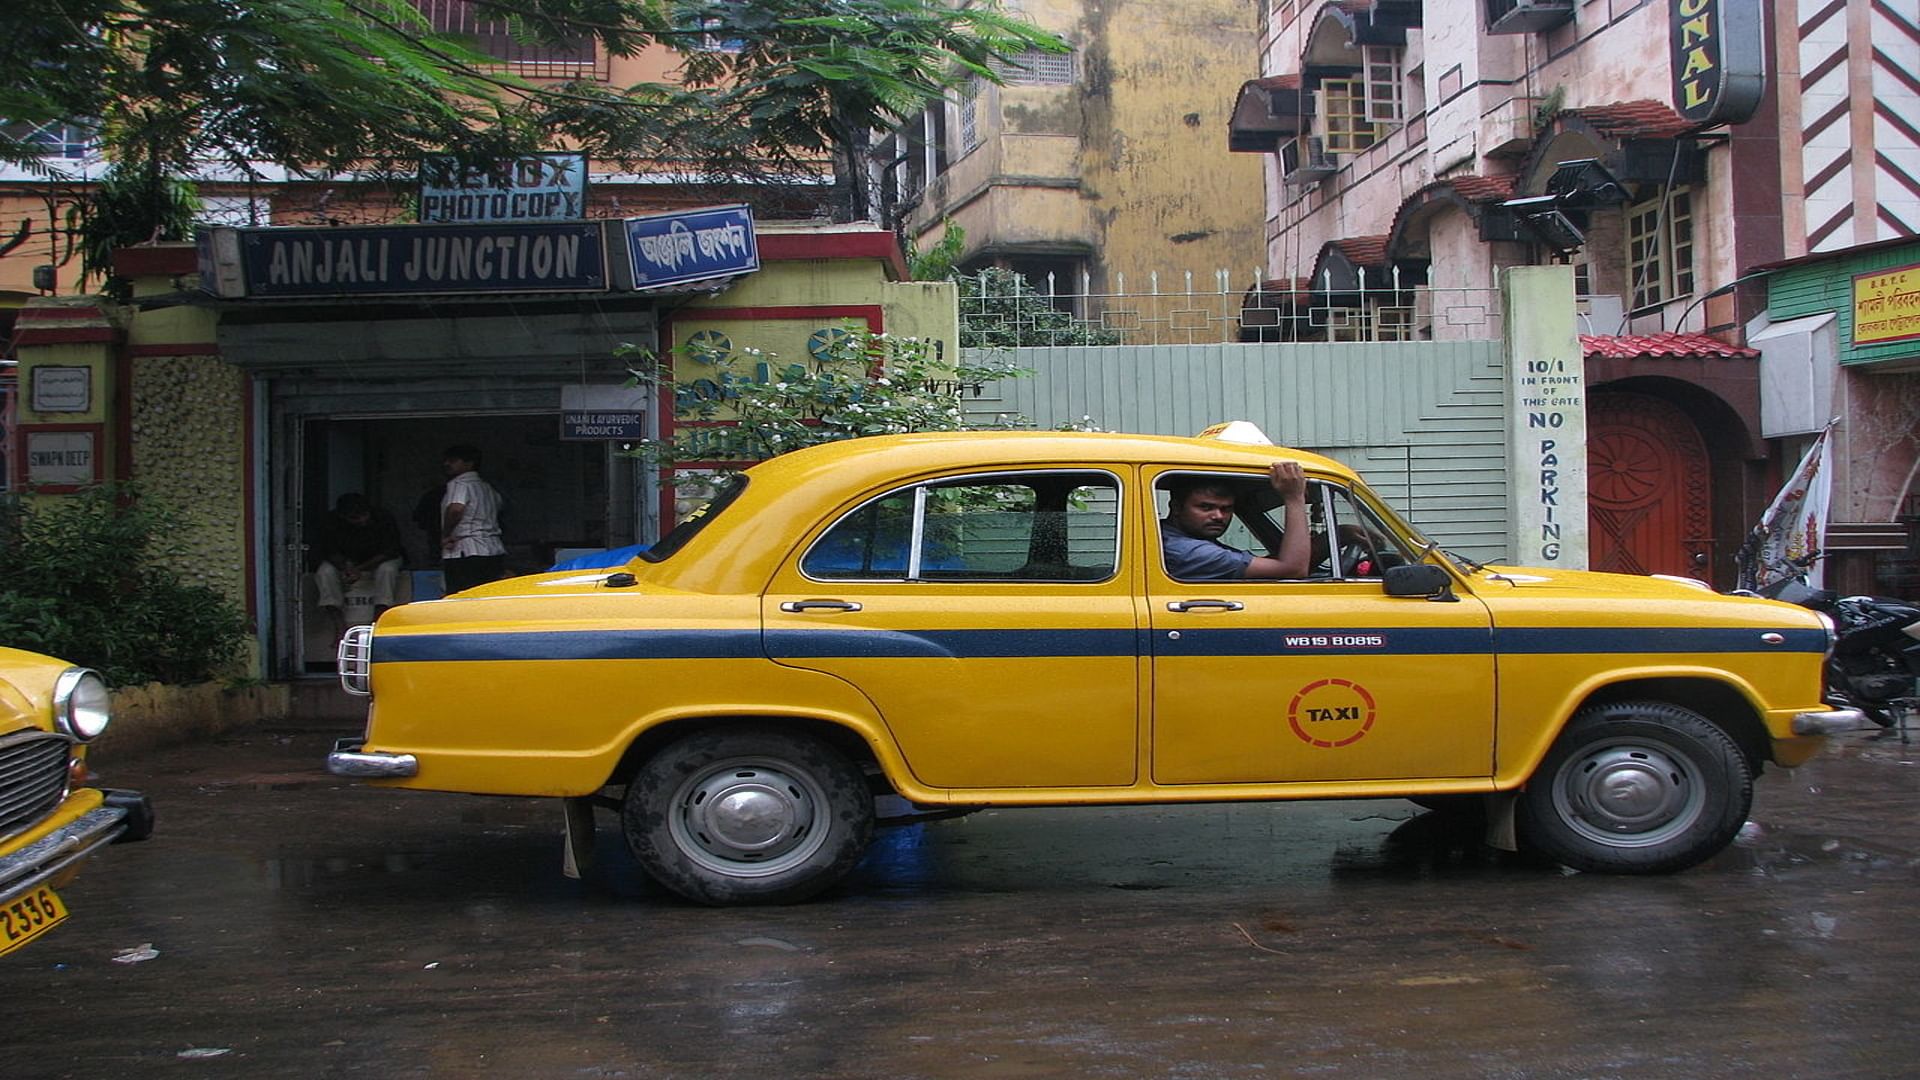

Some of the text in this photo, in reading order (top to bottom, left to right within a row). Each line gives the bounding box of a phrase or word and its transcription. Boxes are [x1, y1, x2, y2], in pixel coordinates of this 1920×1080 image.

[270, 234, 580, 285] ANJALI JUNCTION
[1528, 358, 1564, 375] 10/1
[1521, 376, 1579, 385] IN FRONT
[1523, 397, 1580, 406] THIS GATE
[597, 414, 640, 425] AYURVEDIC
[1529, 412, 1564, 428] NO
[575, 426, 624, 436] PRODUCTS
[1540, 440, 1561, 561] PARKING
[1285, 636, 1328, 647] WB19
[1306, 706, 1360, 722] TAXI
[0, 889, 56, 941] 2336
